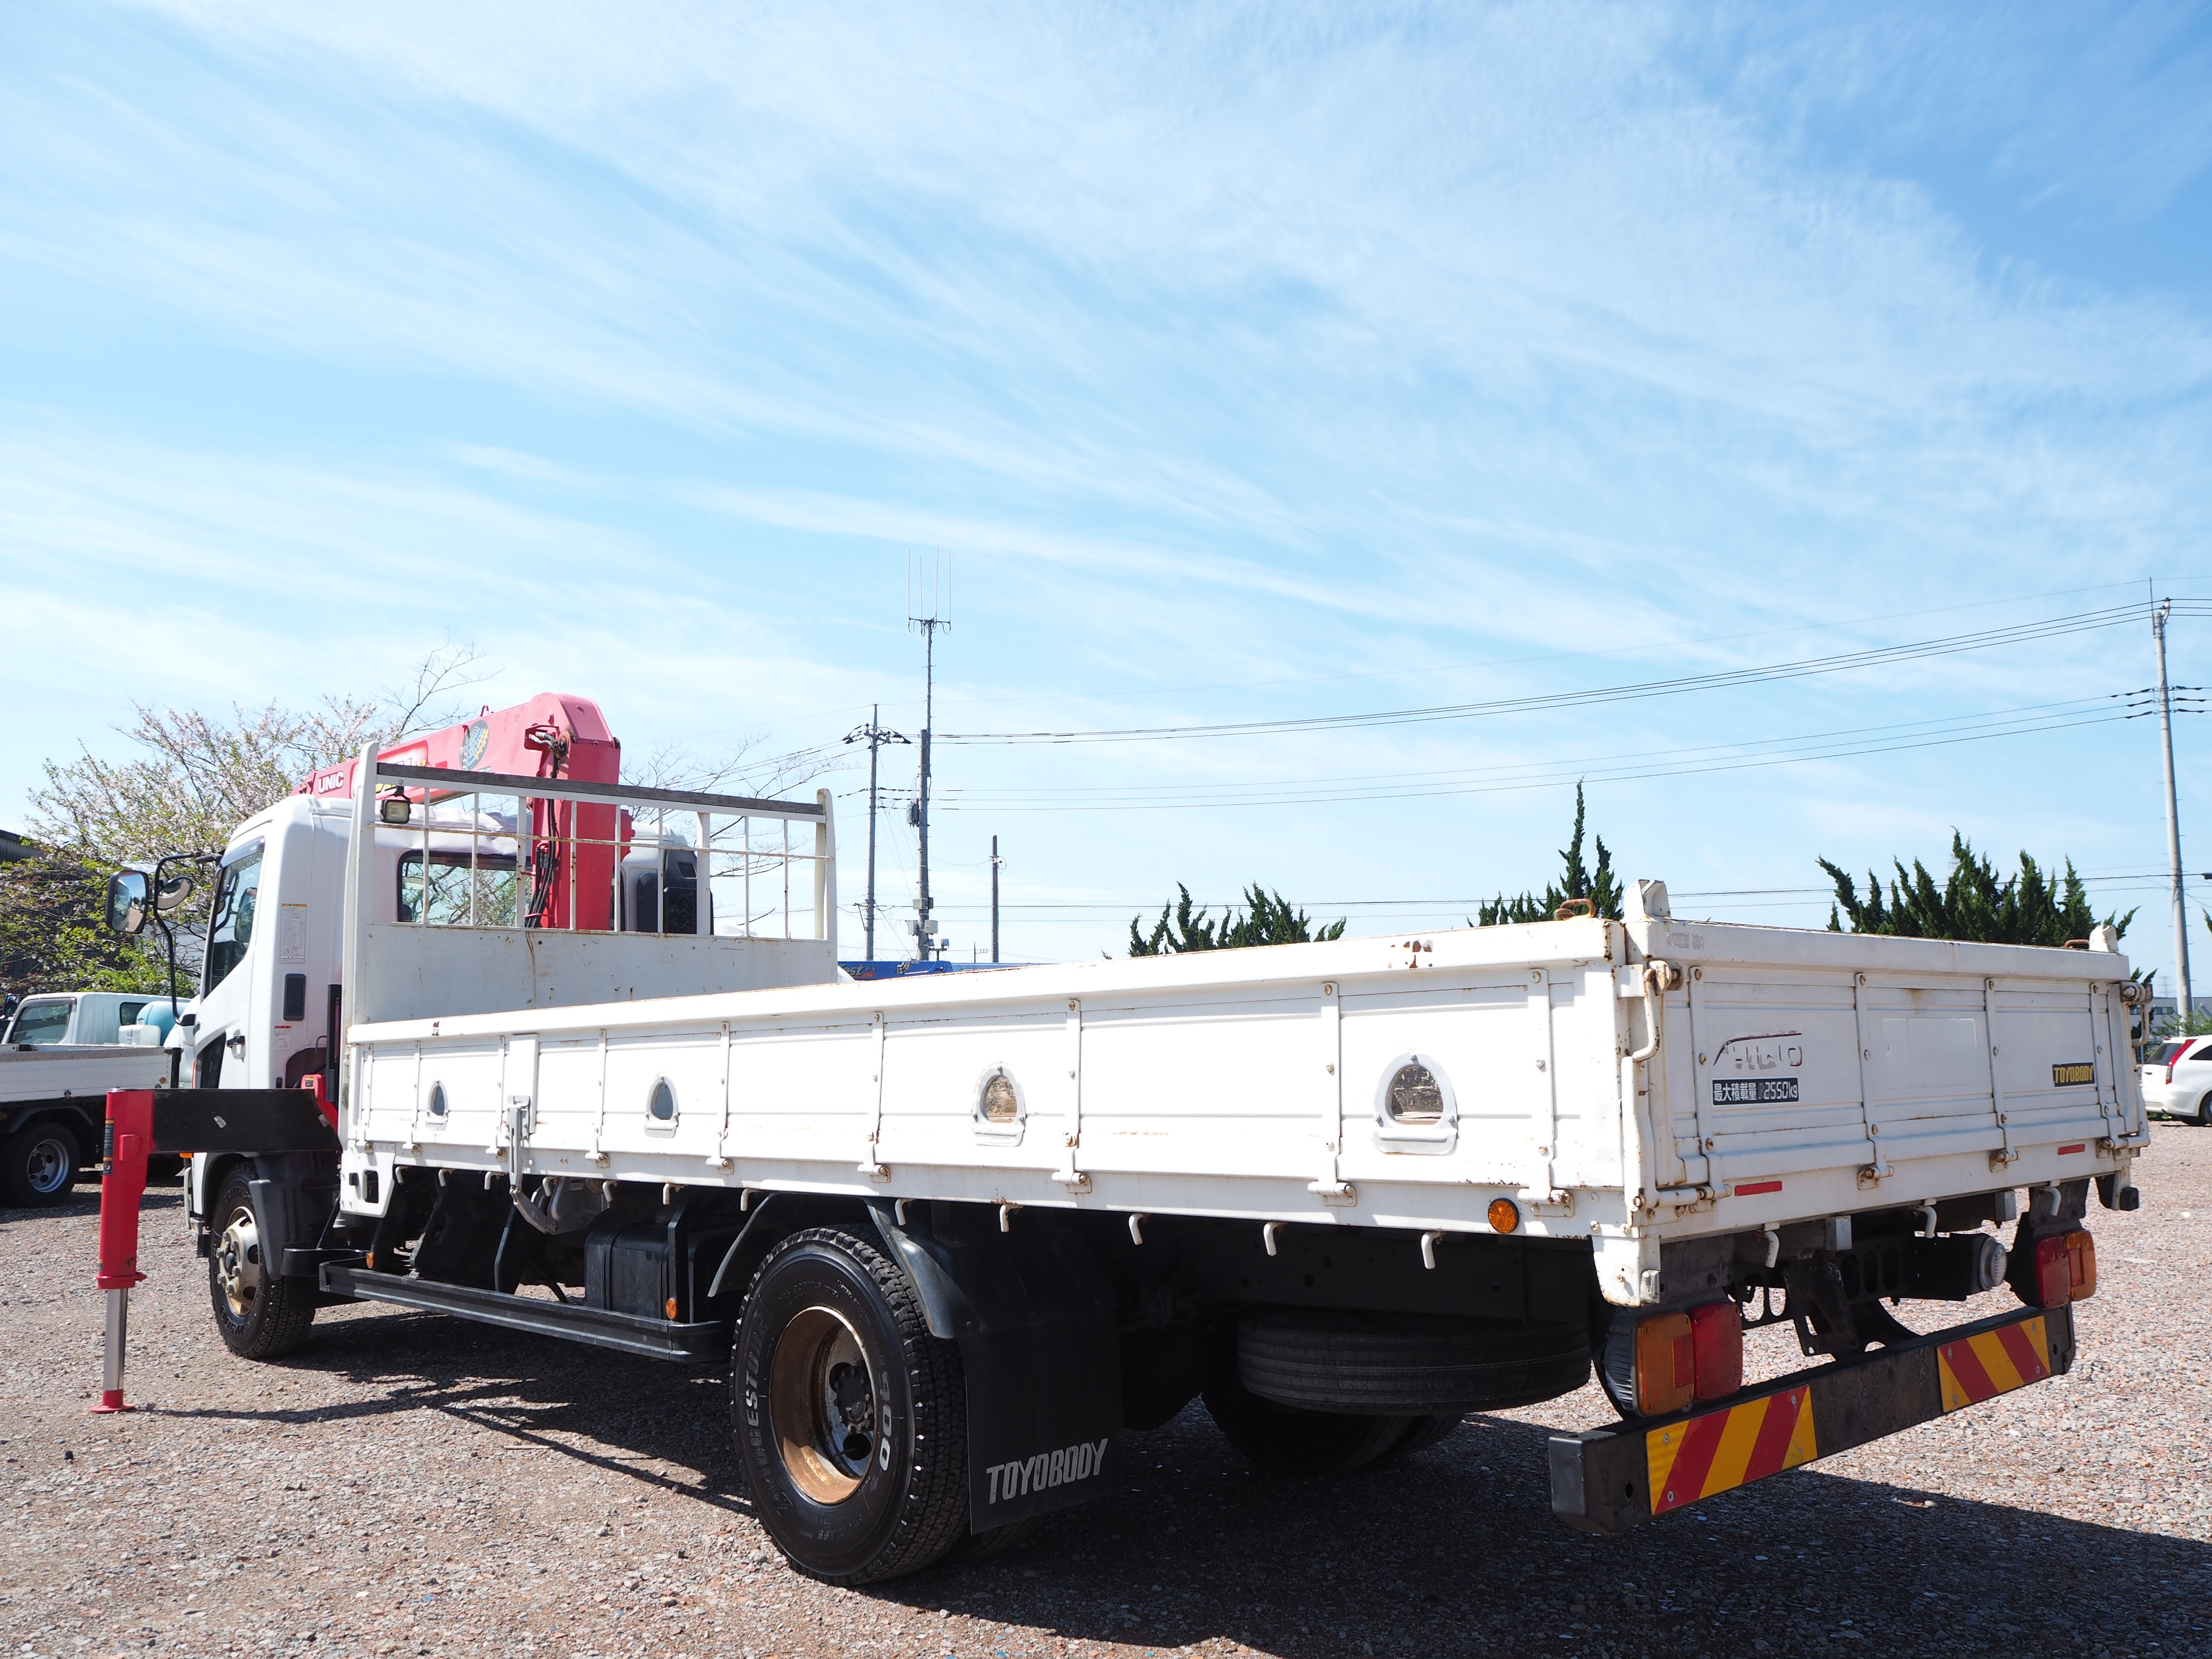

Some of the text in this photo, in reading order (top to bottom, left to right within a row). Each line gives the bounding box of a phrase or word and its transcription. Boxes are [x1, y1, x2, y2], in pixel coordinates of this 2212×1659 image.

[319, 771, 344, 793] UNIC
[2054, 1065, 2093, 1083] TOYOBODY
[1714, 1081, 1798, 1102] 最大積載量 2550kg
[986, 1438, 1108, 1504] TOYOBODY
